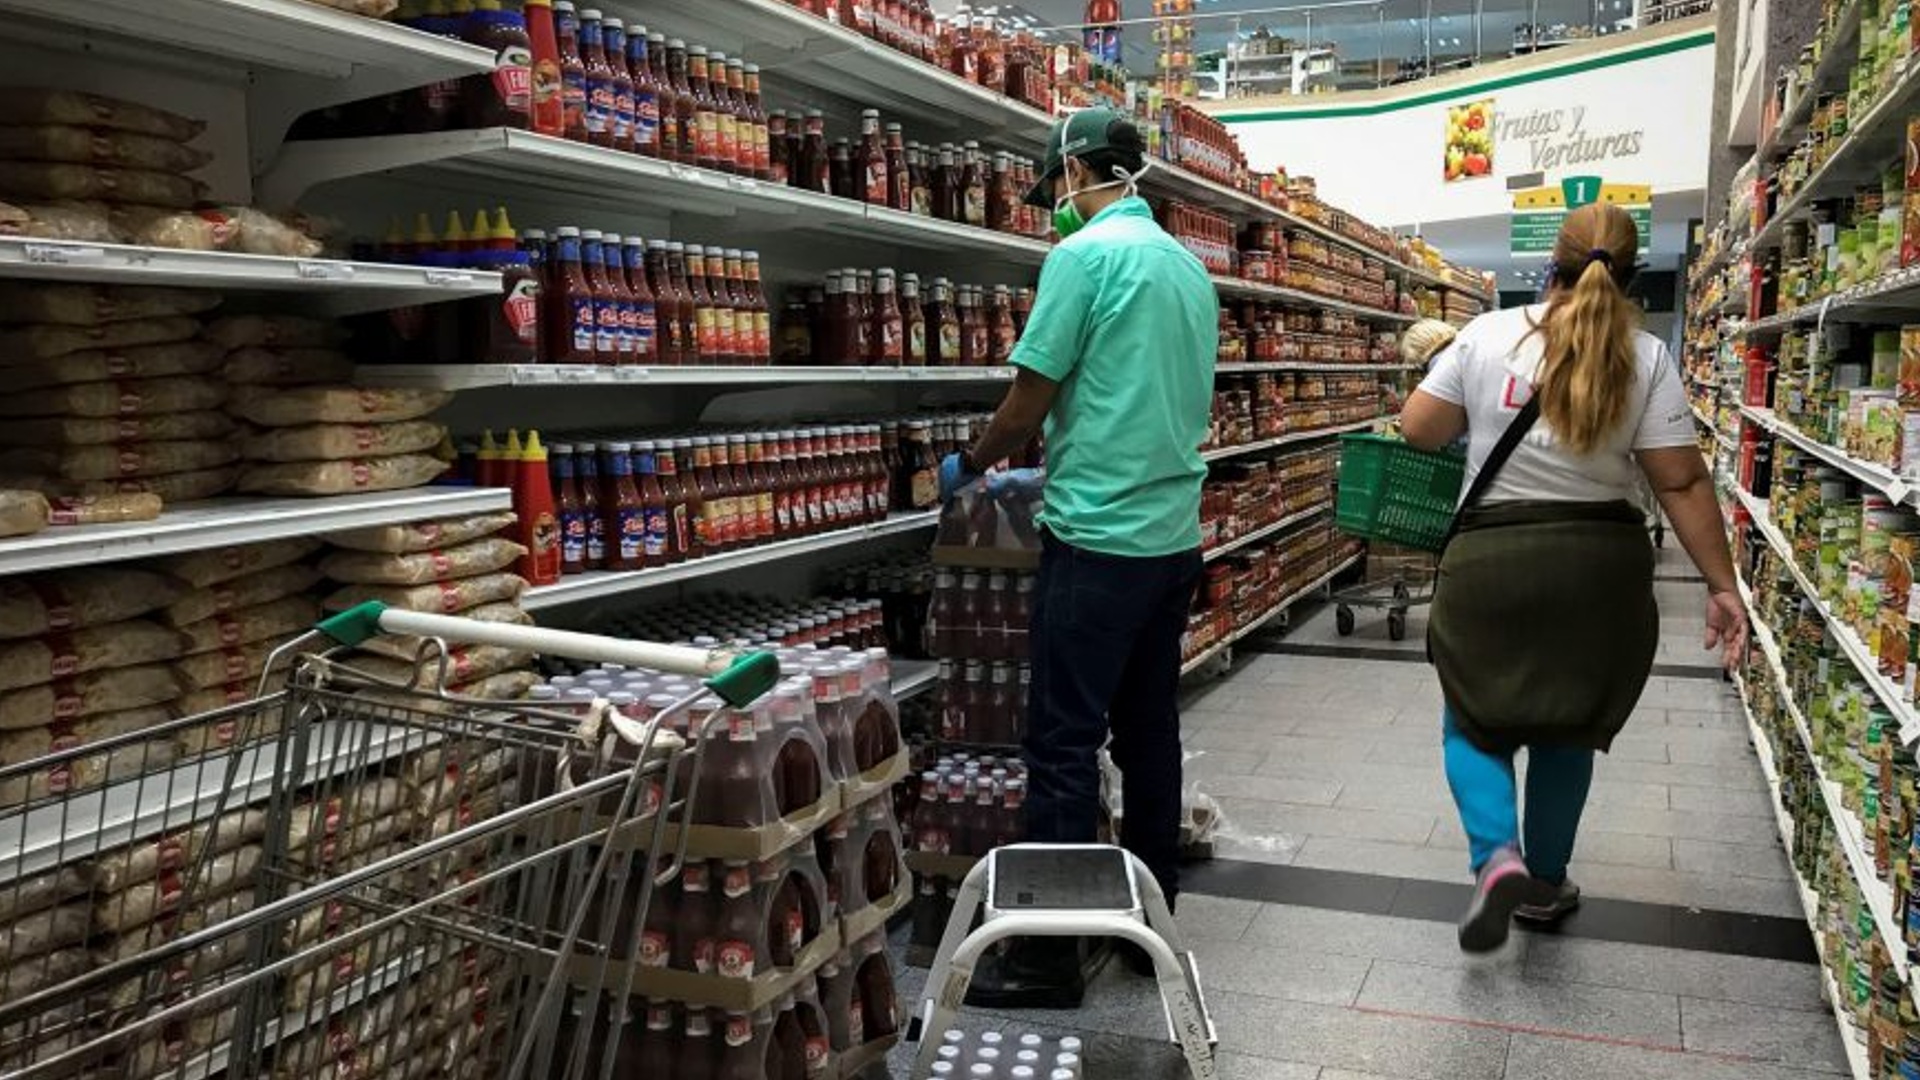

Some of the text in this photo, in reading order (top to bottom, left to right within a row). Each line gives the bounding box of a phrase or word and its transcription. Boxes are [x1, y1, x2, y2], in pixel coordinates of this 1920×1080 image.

[1494, 106, 1587, 141] Frutas y
[1530, 129, 1644, 170] Verduras
[1573, 181, 1587, 204] 1
